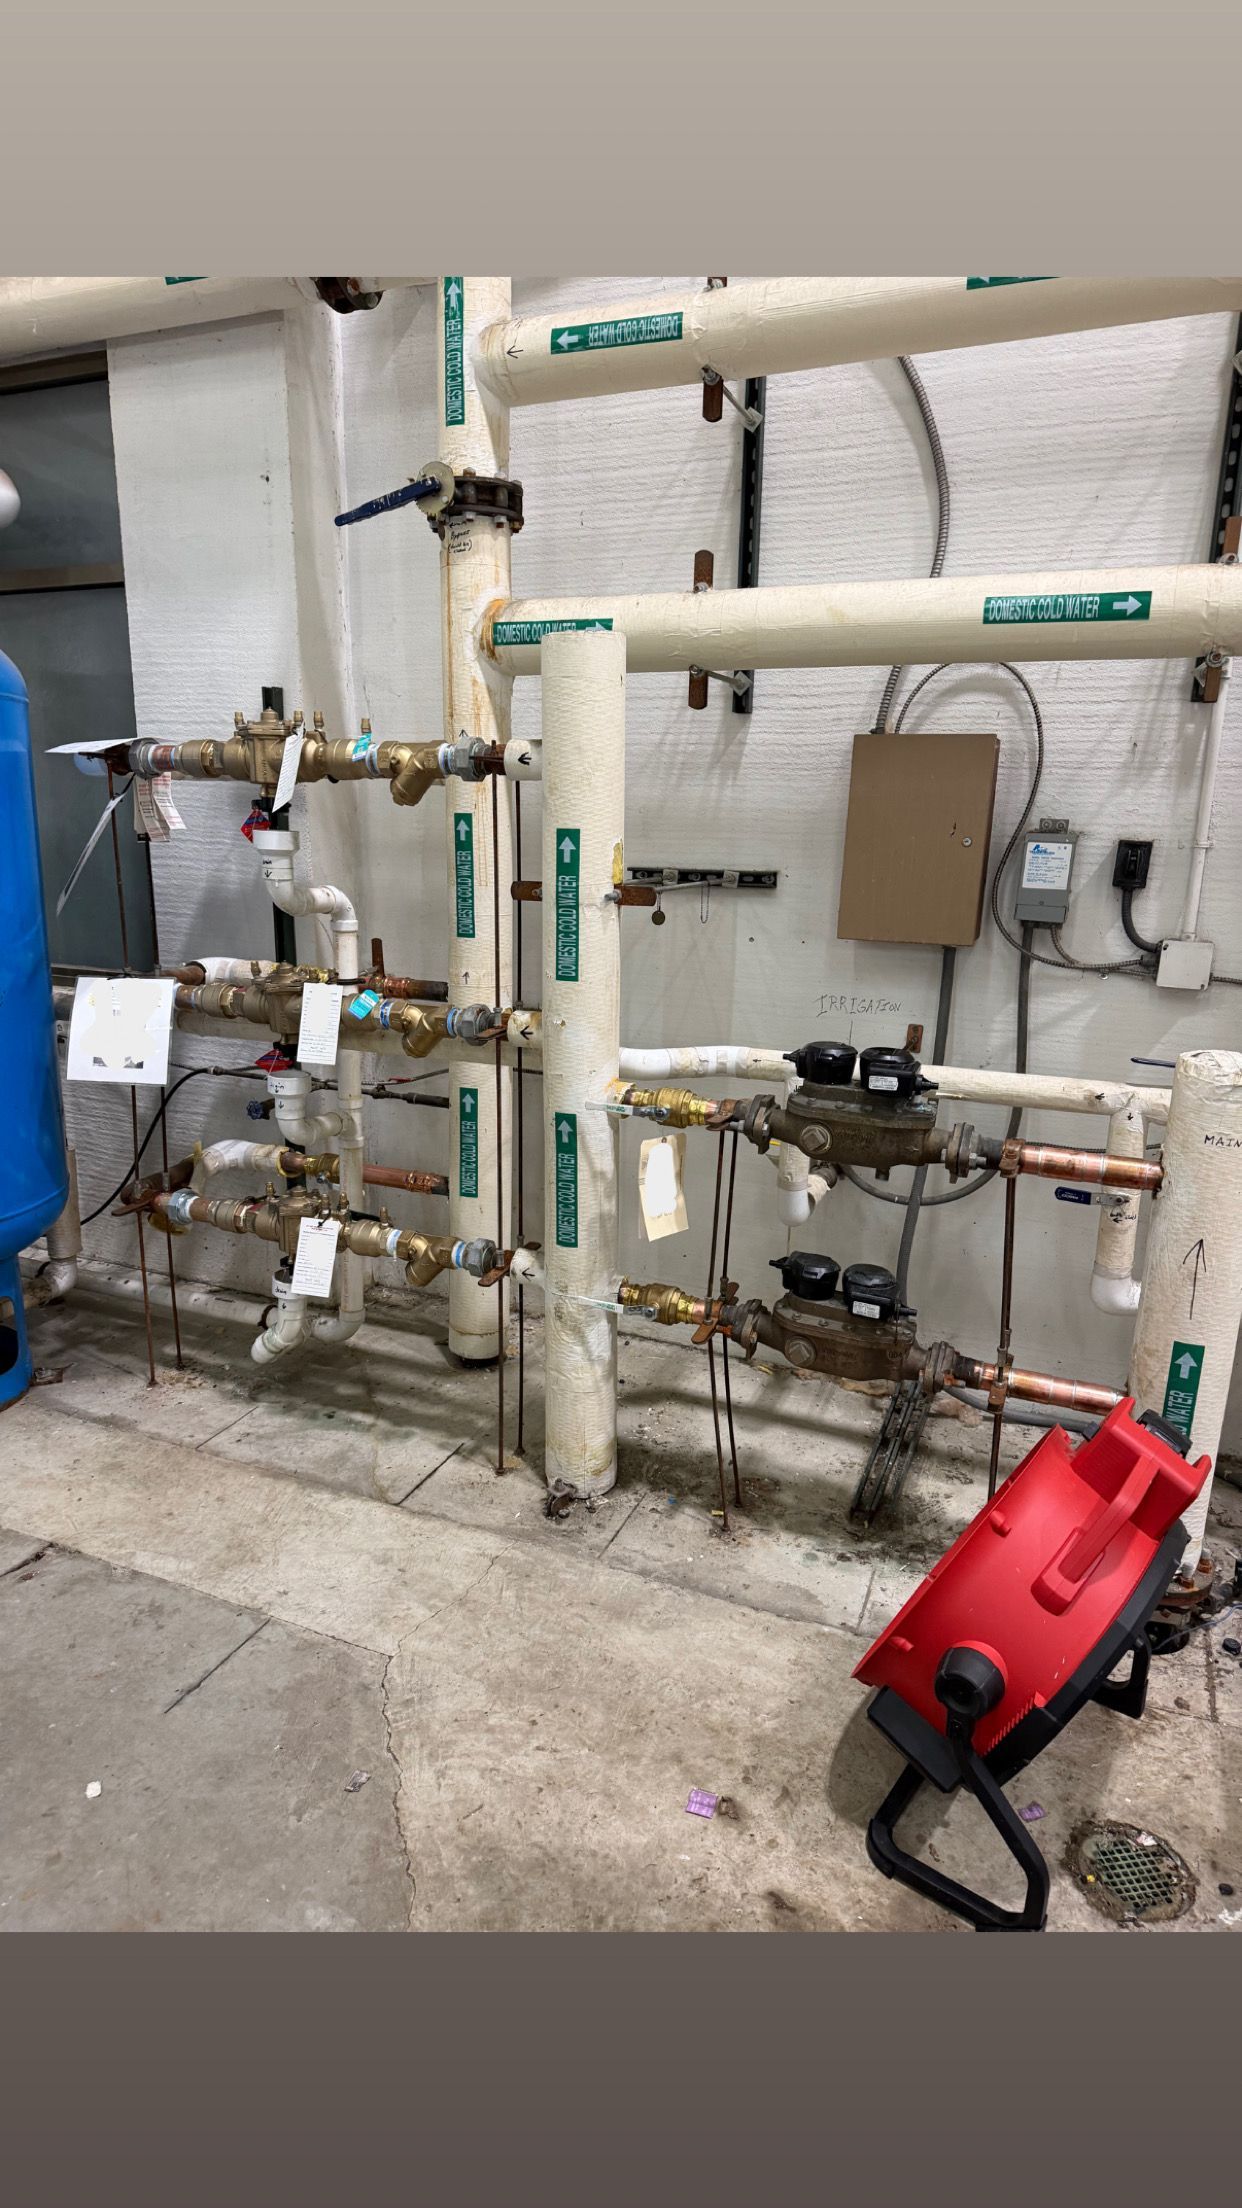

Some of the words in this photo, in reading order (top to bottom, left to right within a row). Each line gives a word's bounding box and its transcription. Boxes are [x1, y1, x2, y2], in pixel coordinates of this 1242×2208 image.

[446, 319, 461, 351] WATER
[588, 323, 616, 347] WATER
[616, 320, 637, 343] COLD
[639, 315, 679, 340] DOMESTIC
[446, 351, 462, 377] COLD
[447, 378, 463, 421] DOMESTIC
[989, 598, 1035, 621] DOMESTIC
[1037, 597, 1062, 620] COLD
[1065, 596, 1100, 619] WATER
[497, 623, 530, 643] DOMESTIC
[456, 850, 471, 876] WATER
[458, 877, 472, 898] COLD
[558, 875, 577, 906] WATER
[458, 898, 473, 934] DOMESTIC
[558, 907, 577, 932] COLD
[558, 933, 577, 977] DOMESTIC
[814, 994, 902, 1017] IRRIGATION
[461, 1120, 476, 1143] WATER
[1204, 1134, 1242, 1148] MAIN
[462, 1144, 476, 1161] COLD
[462, 1162, 476, 1194] DOMESTIC
[558, 1152, 575, 1181] WATER
[558, 1181, 575, 1203] COLD
[558, 1203, 576, 1243] DOMESTIC
[1166, 1389, 1194, 1424] WATER
